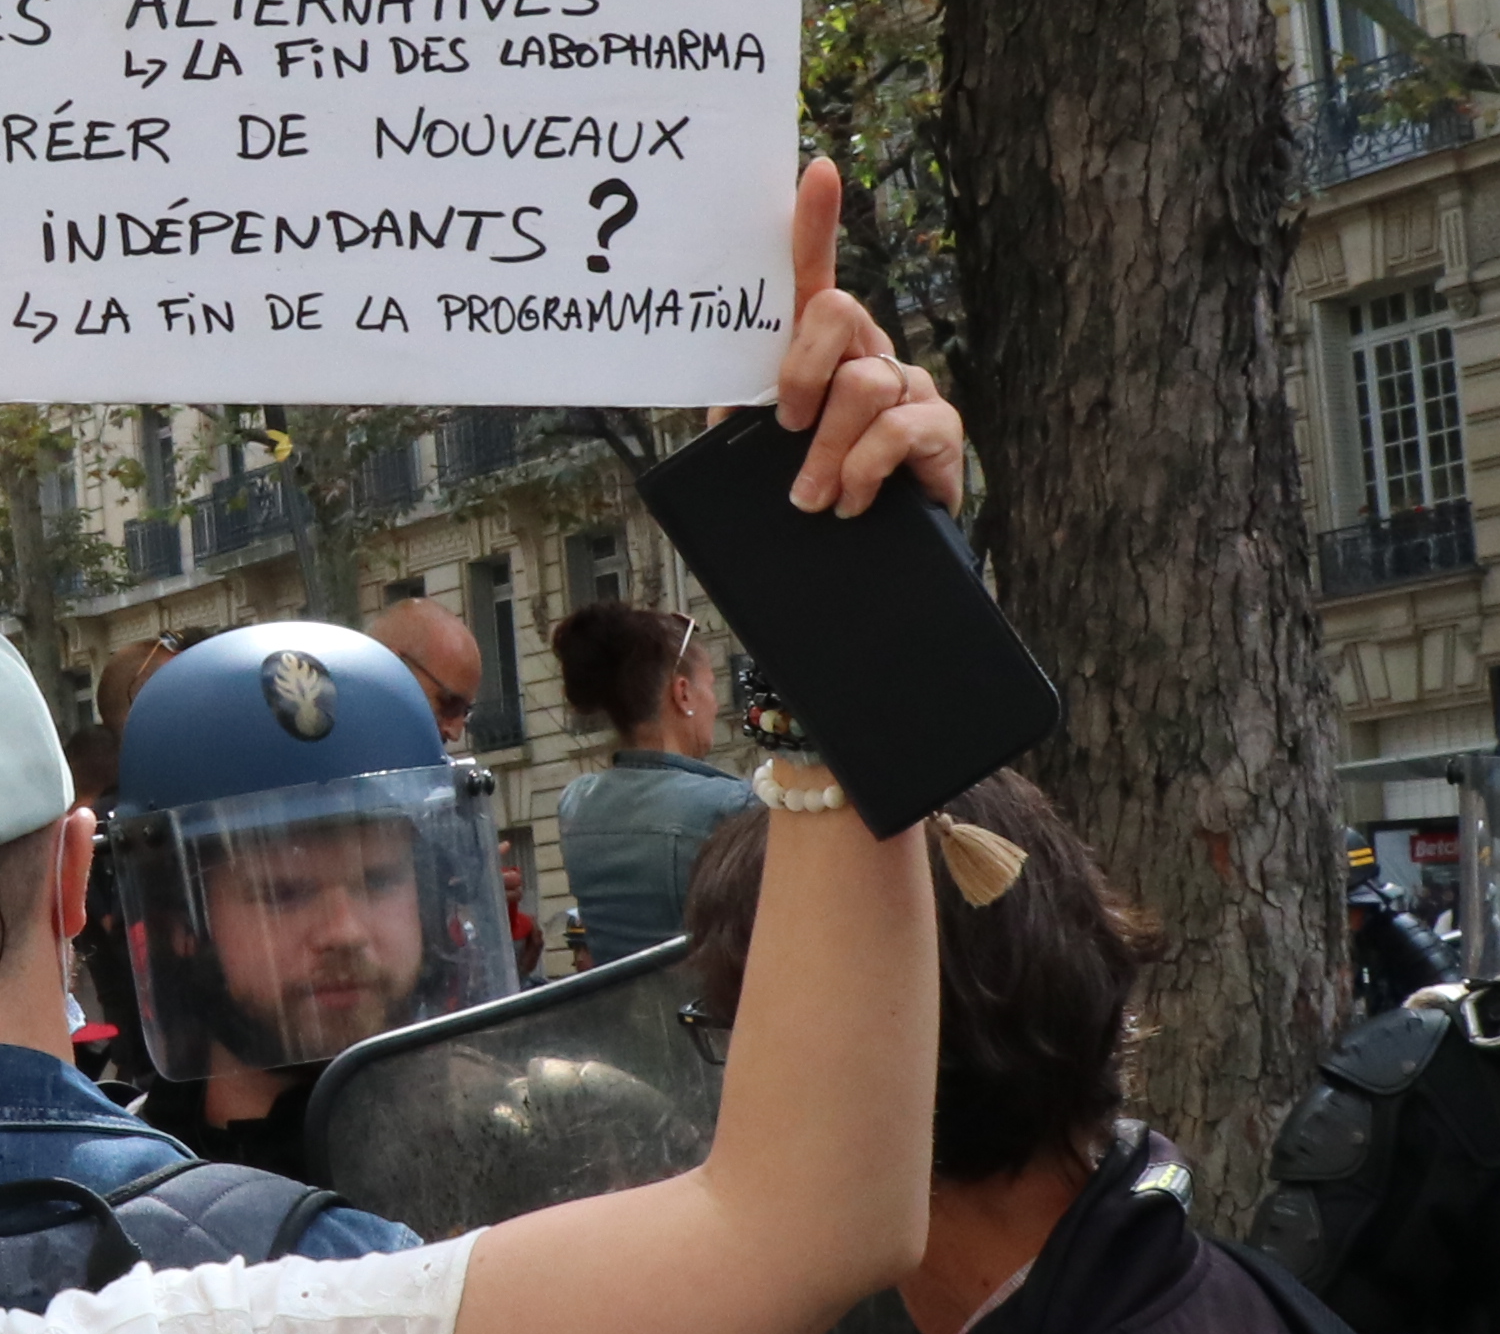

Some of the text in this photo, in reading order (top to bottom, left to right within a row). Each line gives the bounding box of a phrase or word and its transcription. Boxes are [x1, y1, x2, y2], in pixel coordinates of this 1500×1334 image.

[183, 39, 242, 80] LA
[389, 37, 469, 74] DES
[237, 114, 308, 159] DE
[377, 107, 689, 163] NOUVEAUX
[587, 178, 638, 273] ?
[75, 298, 130, 334] LA
[265, 293, 322, 330] DE
[356, 296, 408, 332] LA
